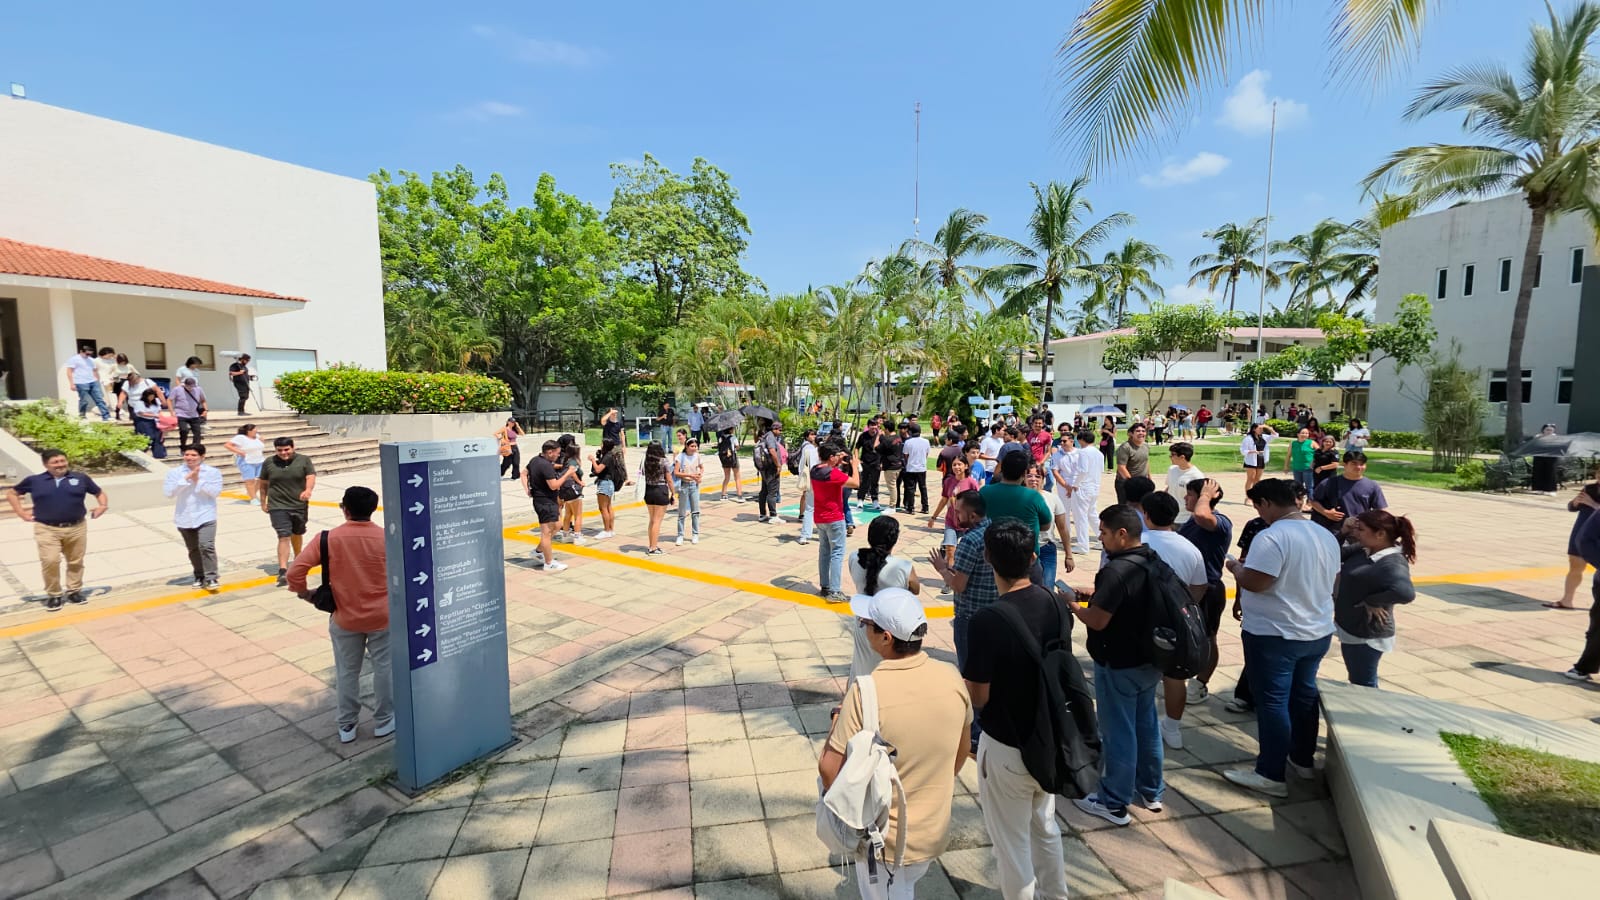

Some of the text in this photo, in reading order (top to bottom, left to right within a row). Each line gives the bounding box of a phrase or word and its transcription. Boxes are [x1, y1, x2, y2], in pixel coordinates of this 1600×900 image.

[433, 469, 453, 477] Salida
[459, 491, 488, 500] Maestros
[440, 607, 471, 621] Reptilario
